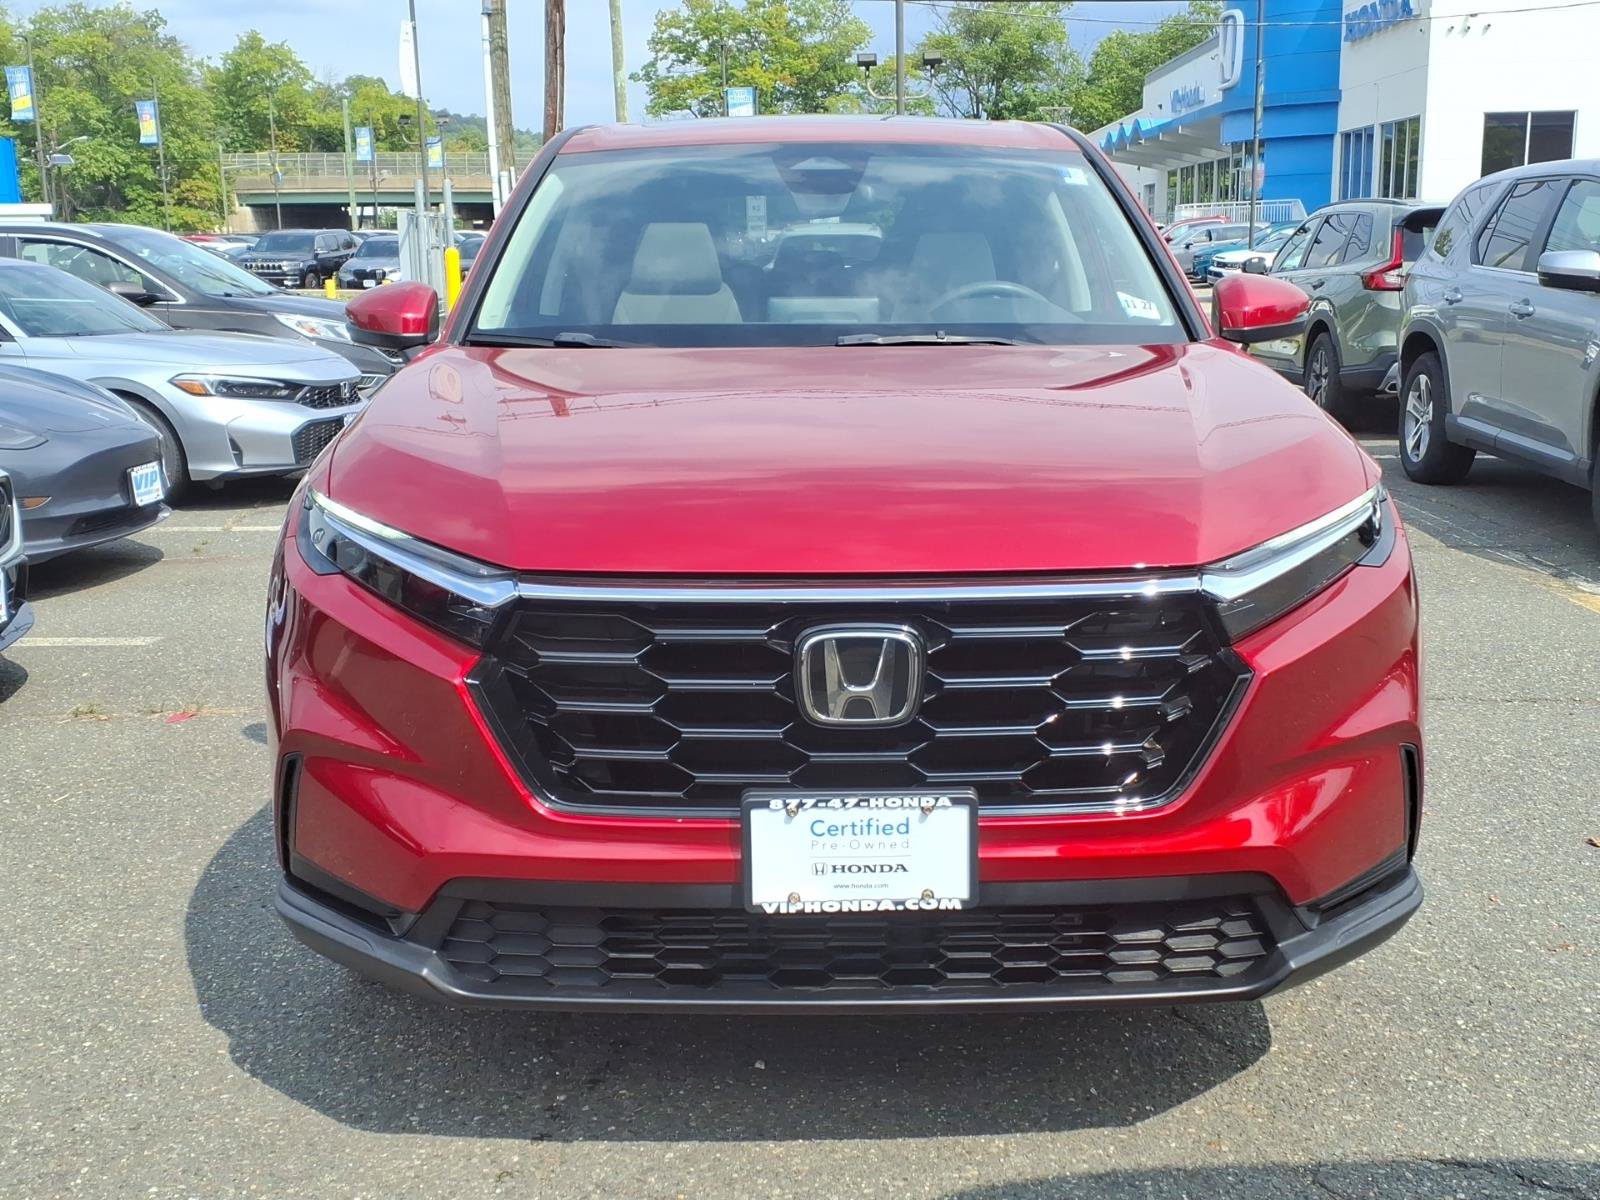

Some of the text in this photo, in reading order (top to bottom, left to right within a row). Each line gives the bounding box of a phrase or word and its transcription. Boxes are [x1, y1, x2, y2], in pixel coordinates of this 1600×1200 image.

[133, 471, 158, 490] VIP
[769, 796, 952, 810] 877-47-HONDA
[810, 816, 909, 837] Certified
[811, 839, 909, 850] Pre-Owned
[831, 864, 909, 874] HONDA
[833, 882, 889, 890] www.honda.com
[761, 898, 962, 914] VIPHONDA.COM
